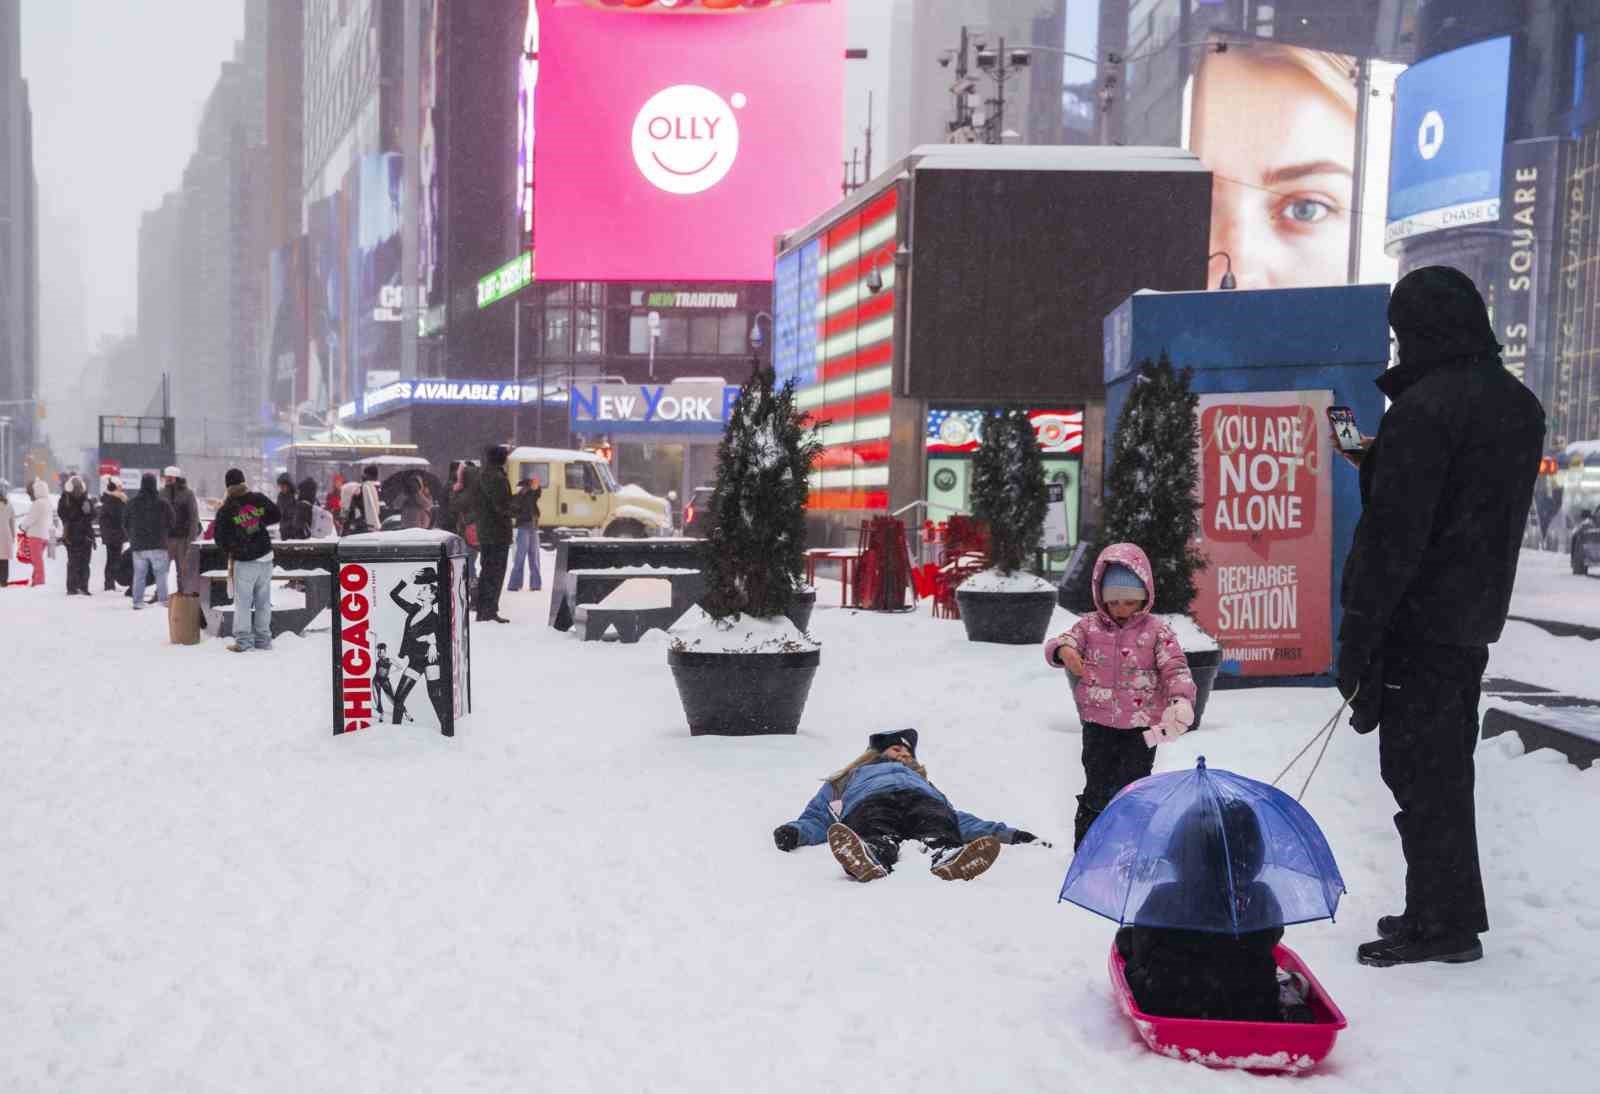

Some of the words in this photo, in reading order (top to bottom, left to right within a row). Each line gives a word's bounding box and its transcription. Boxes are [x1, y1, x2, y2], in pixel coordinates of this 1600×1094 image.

[648, 116, 721, 140] OLLY
[1508, 167, 1538, 291] SQUARE
[1503, 322, 1528, 384] MES
[412, 383, 499, 401] AVAILABLE
[1216, 415, 1257, 451] YOU
[1262, 416, 1303, 454] ARE
[1219, 453, 1304, 497] NOT
[1215, 495, 1302, 530] ALONE
[1218, 565, 1298, 595] RECHARGE
[1218, 585, 1297, 630] STATION
